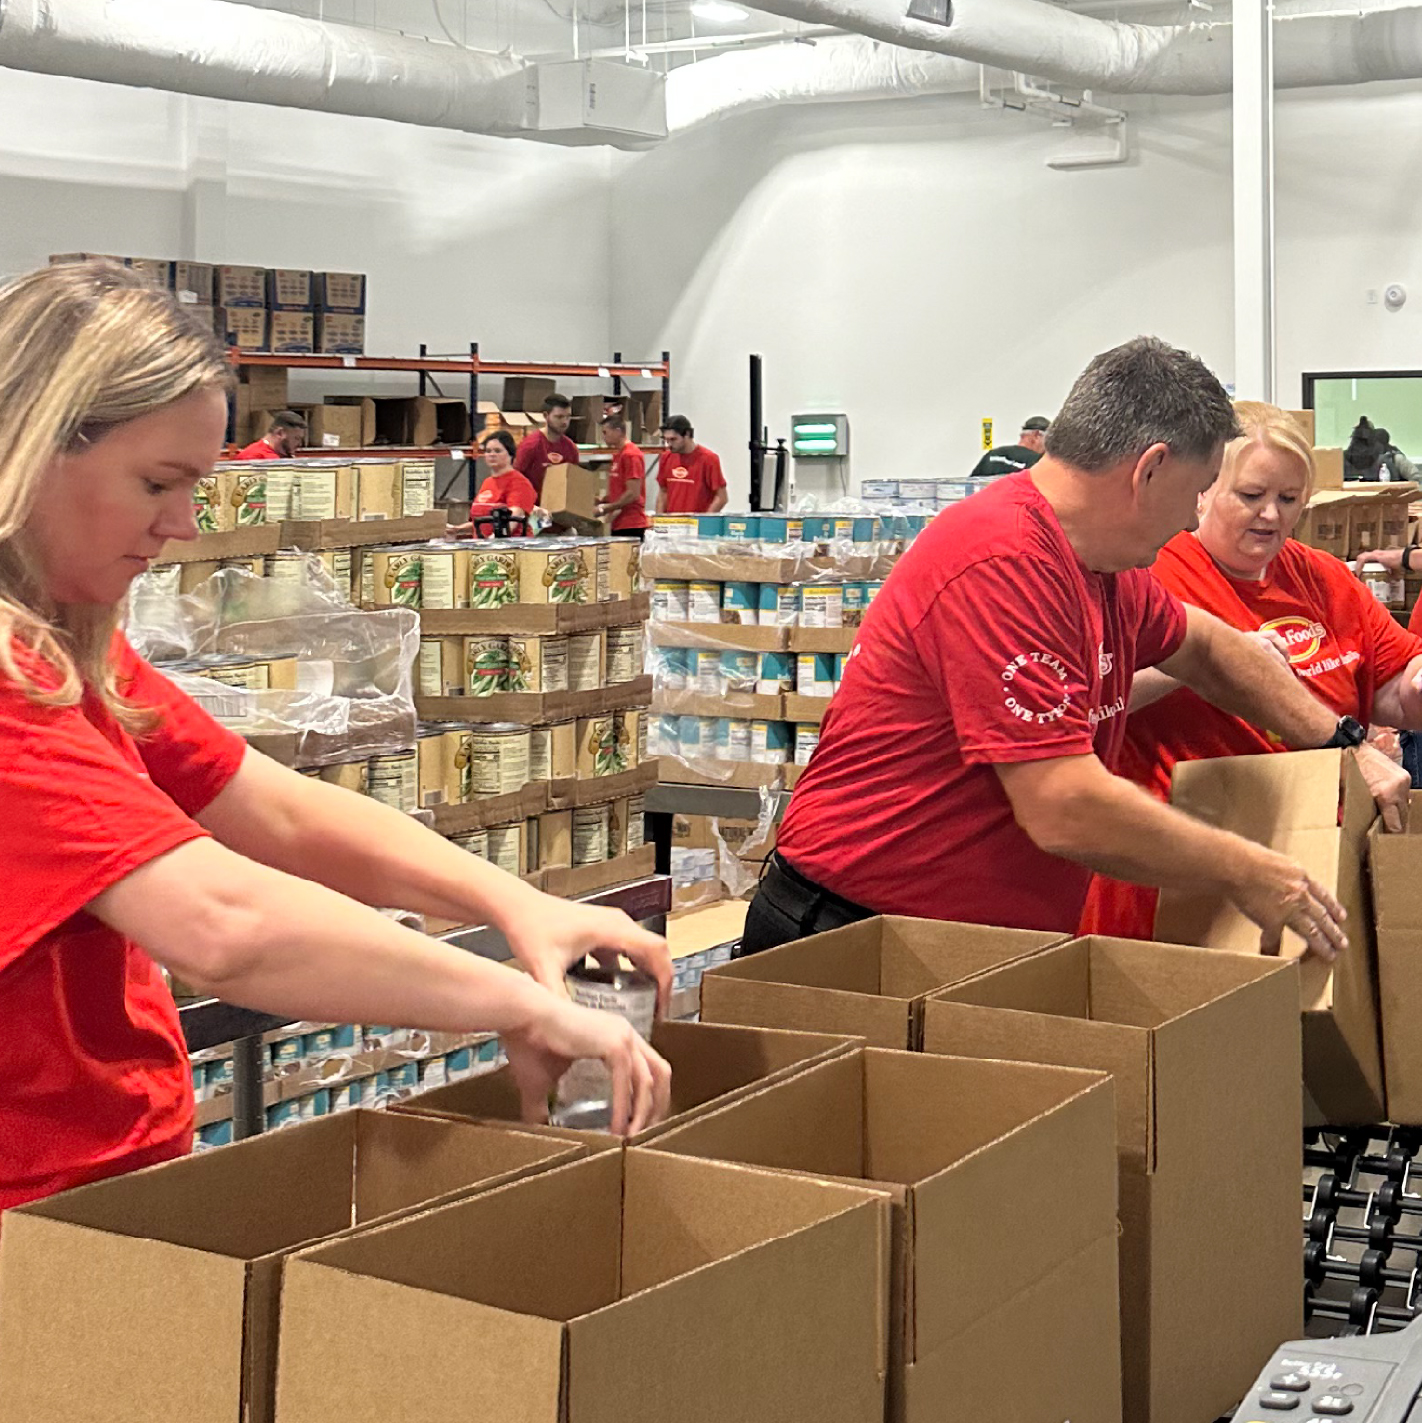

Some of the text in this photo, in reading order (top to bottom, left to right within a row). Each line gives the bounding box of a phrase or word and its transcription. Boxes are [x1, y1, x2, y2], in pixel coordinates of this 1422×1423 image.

[1285, 622, 1326, 646] Foods
[1001, 652, 1068, 681] ONE TEAM
[1004, 697, 1034, 722] ONE
